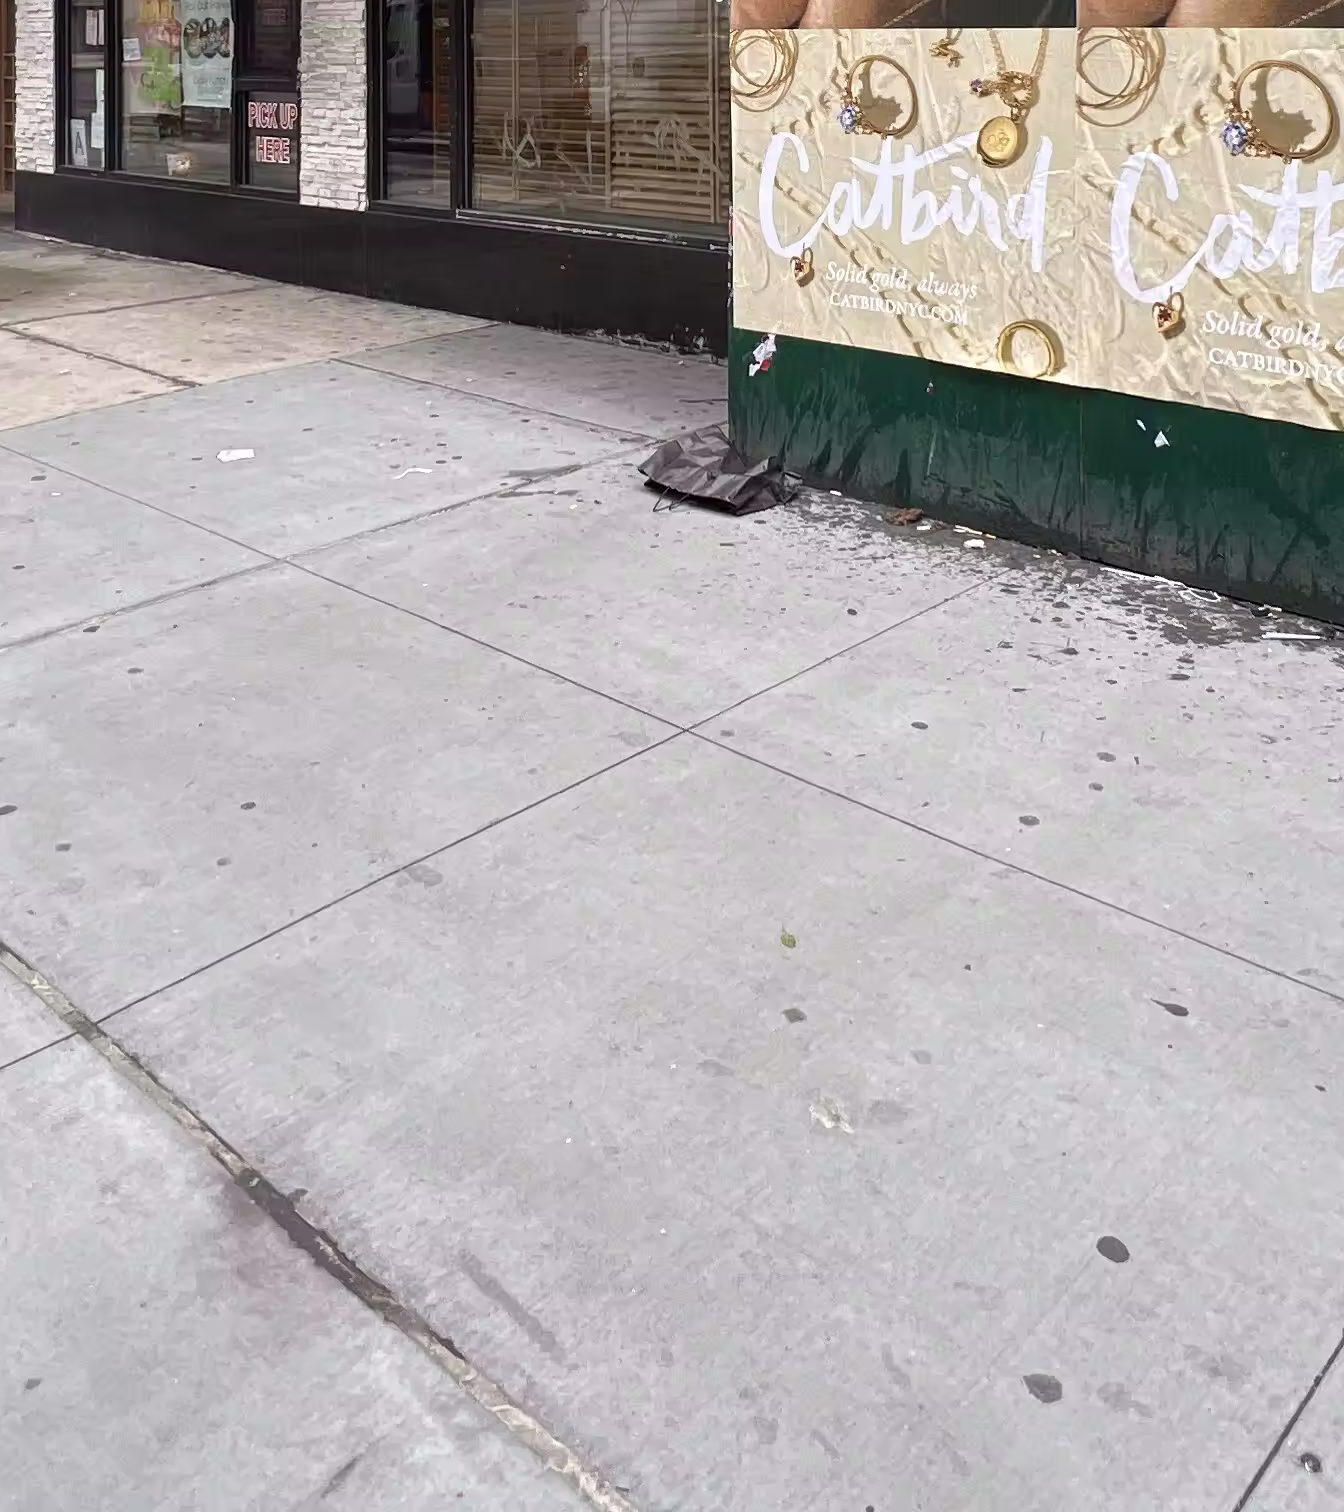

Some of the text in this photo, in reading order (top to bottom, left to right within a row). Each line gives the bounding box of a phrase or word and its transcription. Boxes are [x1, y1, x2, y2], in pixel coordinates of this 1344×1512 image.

[248, 101, 299, 130] PICK UP
[256, 135, 291, 164] HERE
[758, 131, 1054, 273] Catbird
[825, 260, 978, 303] Solid gold, always
[829, 291, 969, 325] CATBIRDNYC.COM
[1202, 309, 1264, 339] Solid
[1264, 320, 1330, 352] gold,
